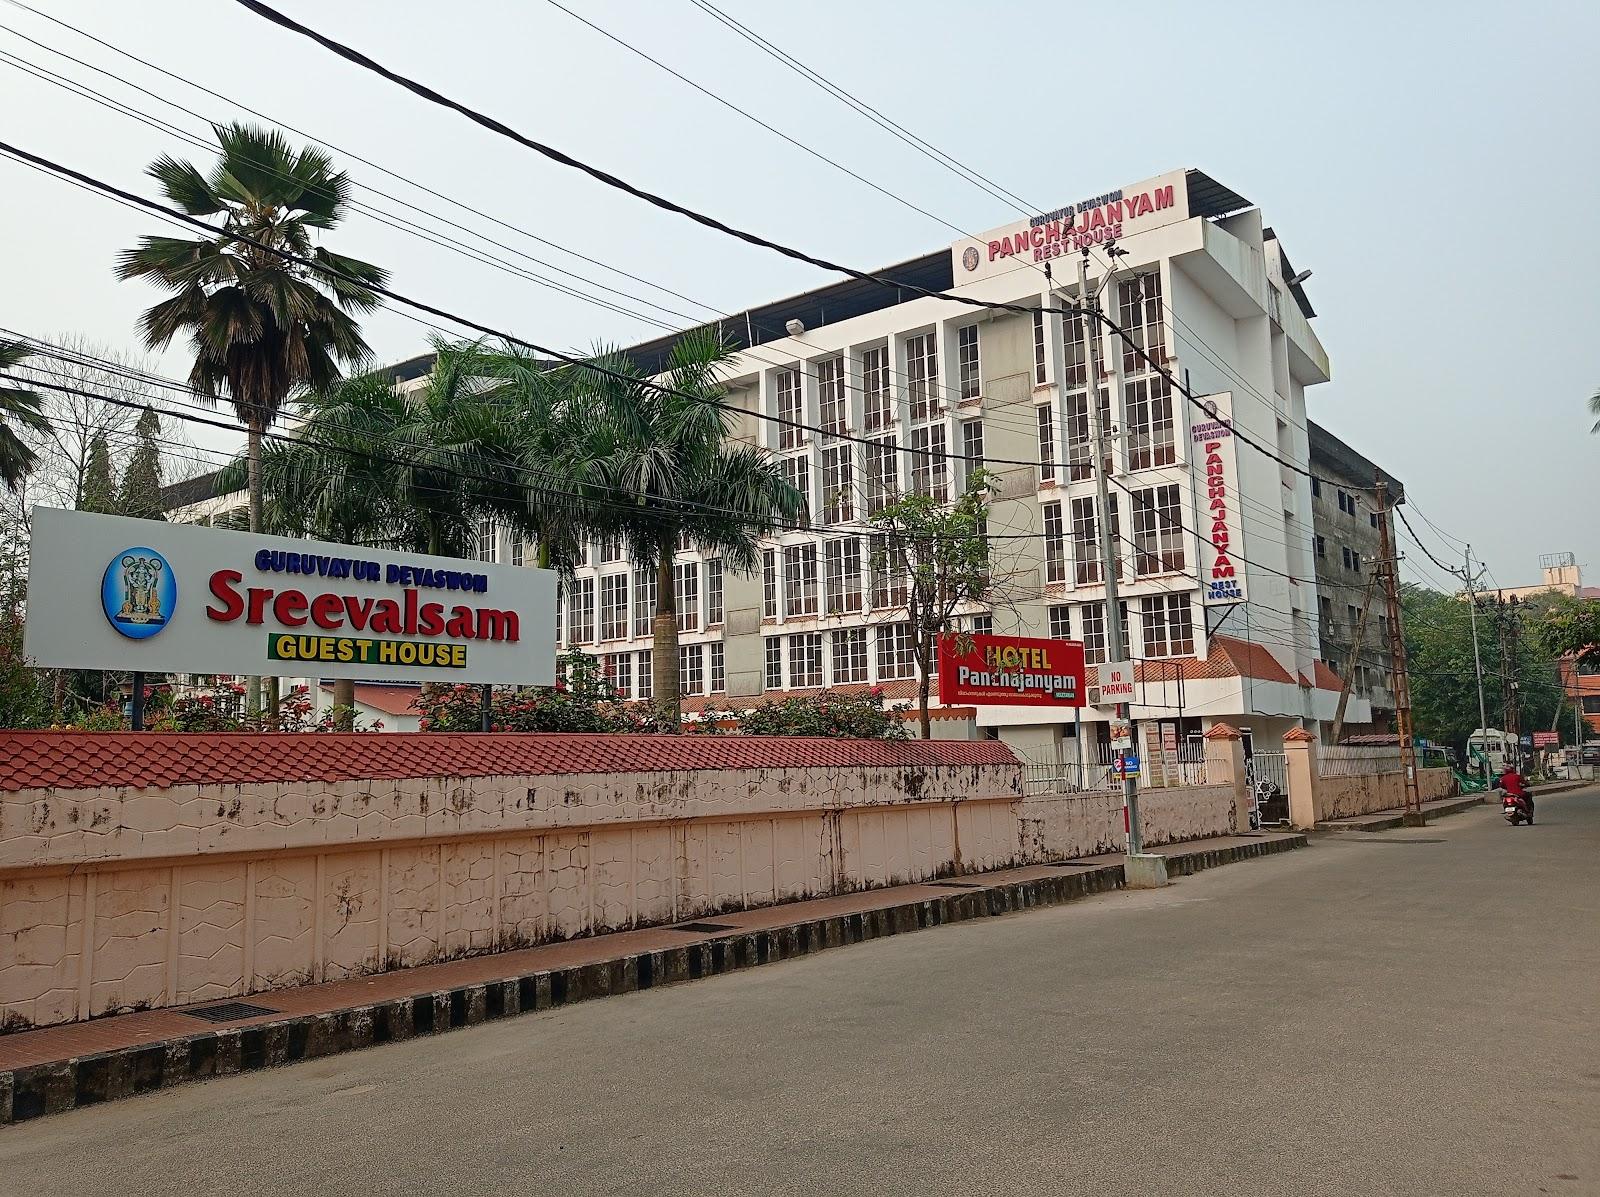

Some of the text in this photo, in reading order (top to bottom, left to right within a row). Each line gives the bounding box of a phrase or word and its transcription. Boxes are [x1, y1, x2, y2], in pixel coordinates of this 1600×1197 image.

[988, 185, 1174, 262] PANCHAJANYAM
[1029, 190, 1122, 228] GURUVAYUR DEVASWOM
[1033, 224, 1123, 262] REST HOUSE
[1205, 442, 1235, 579] PANCHAJANYAM
[254, 548, 488, 594] GURUVAYUR DEVASWOM
[1211, 580, 1237, 590] REST
[206, 569, 520, 642] Sreevalsam
[1207, 588, 1242, 600] HOUSE
[276, 635, 466, 666] GUEST HOUSE
[986, 645, 1052, 670] HOTEL
[959, 666, 1077, 694] Panchajanyam
[1102, 682, 1133, 696] PARKING
[1111, 671, 1121, 683] NO
